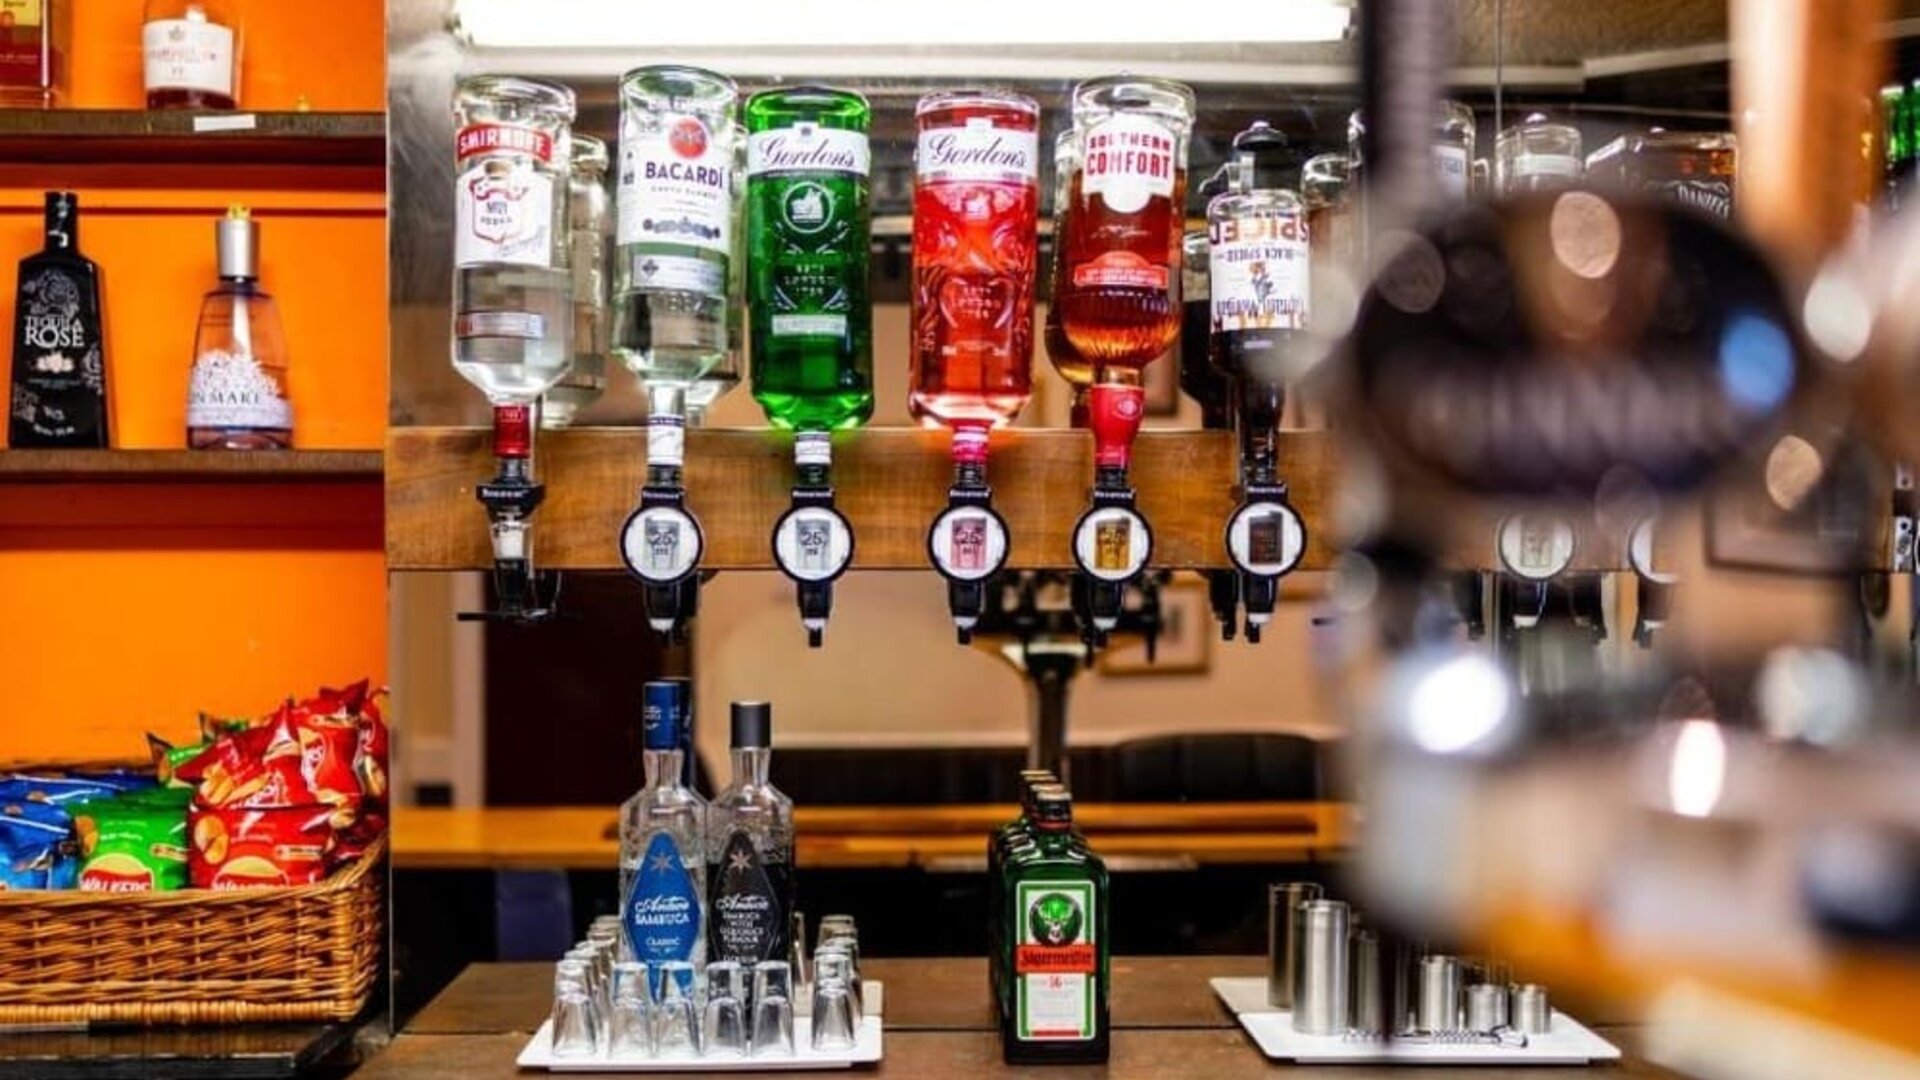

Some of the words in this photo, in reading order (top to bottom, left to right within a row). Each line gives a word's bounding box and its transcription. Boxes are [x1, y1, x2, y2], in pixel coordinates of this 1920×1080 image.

[928, 133, 1027, 168] Gordon's
[1089, 132, 1170, 151] SOUTHERN
[1087, 151, 1170, 178] COMFORT
[24, 326, 85, 348] ROSE
[802, 531, 823, 546] 25
[634, 912, 690, 925] SAMBUCA
